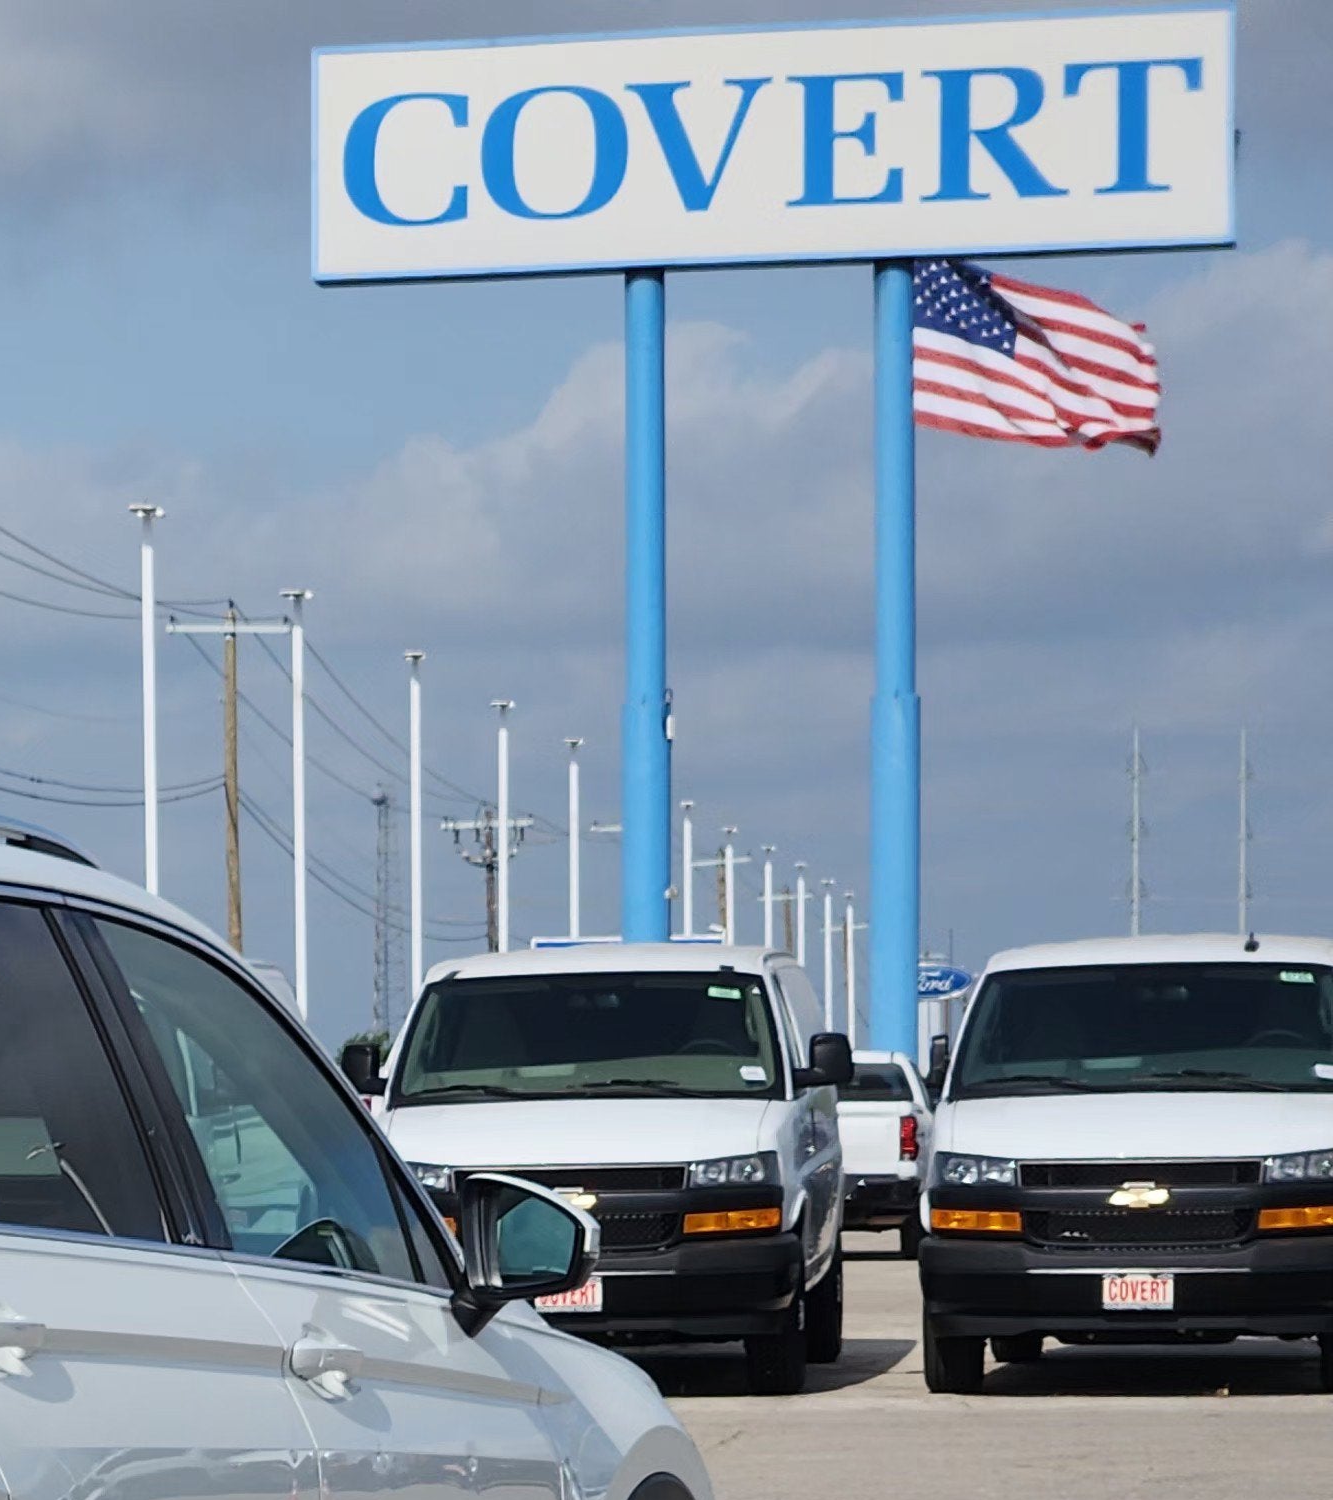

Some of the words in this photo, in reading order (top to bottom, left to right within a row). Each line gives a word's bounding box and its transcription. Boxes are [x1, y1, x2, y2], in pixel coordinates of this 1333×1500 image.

[342, 56, 1204, 228] COVERT
[918, 971, 955, 992] Ford
[1108, 1279, 1168, 1302] COVERT
